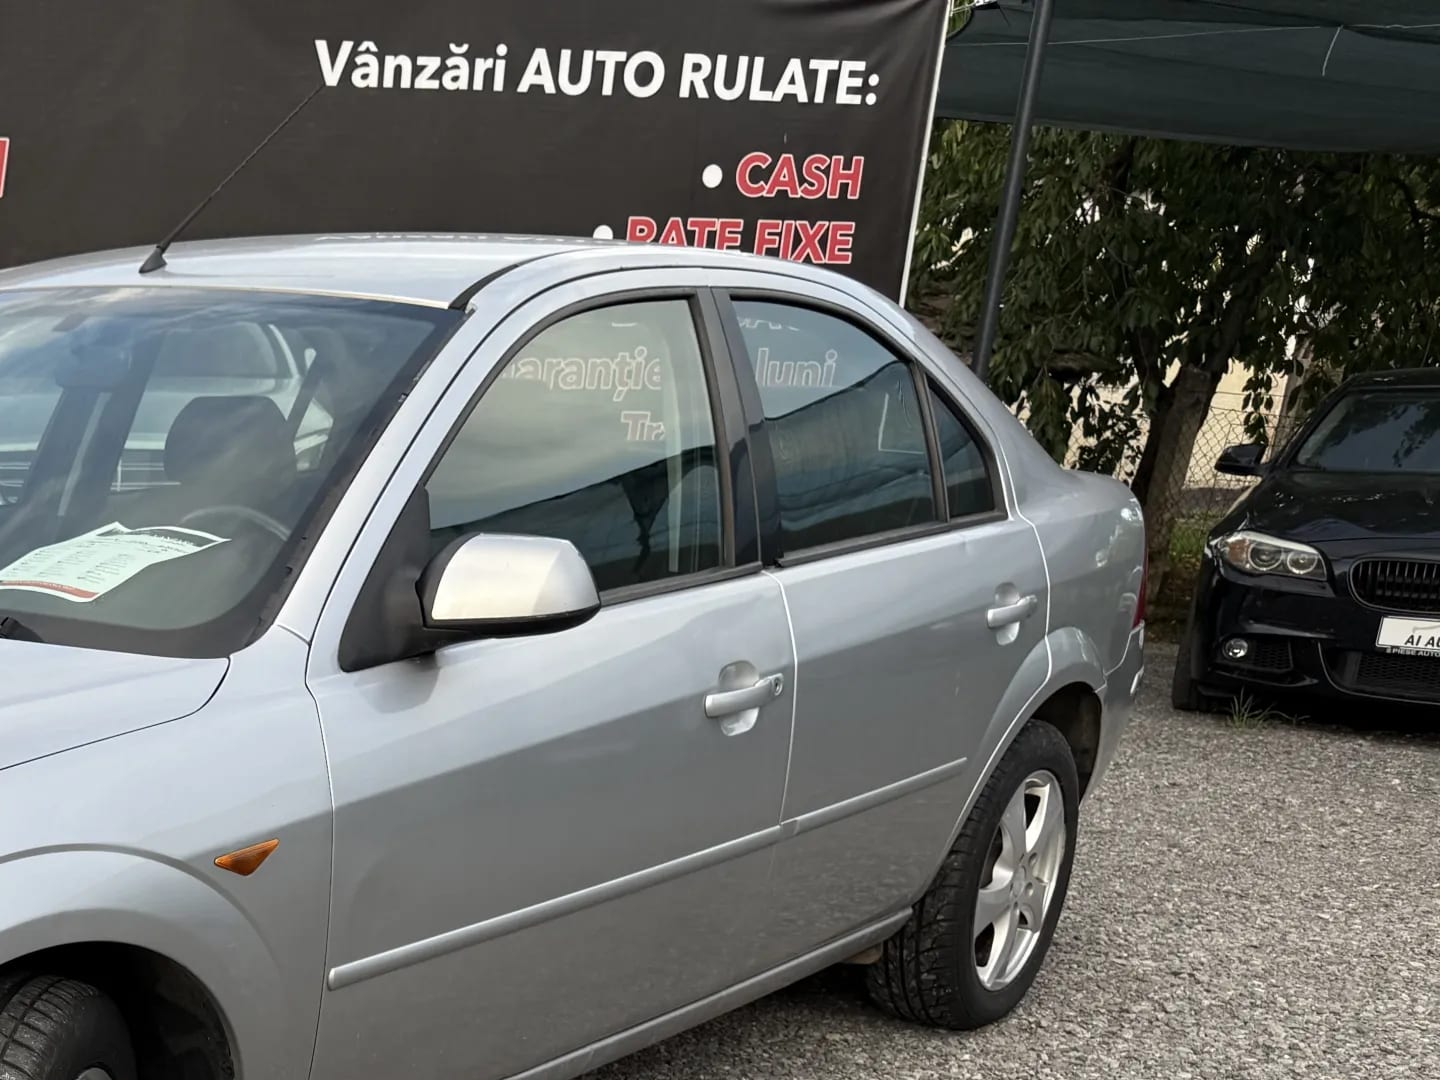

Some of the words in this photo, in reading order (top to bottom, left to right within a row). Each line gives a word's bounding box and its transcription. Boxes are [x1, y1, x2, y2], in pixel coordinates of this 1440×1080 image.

[314, 39, 508, 92] Vânzări
[516, 47, 666, 98] AUTO
[678, 53, 881, 106] RULATE:
[735, 151, 865, 199] CASH
[753, 219, 856, 264] FIXE
[755, 347, 838, 387] luni
[1404, 634, 1423, 647] AI
